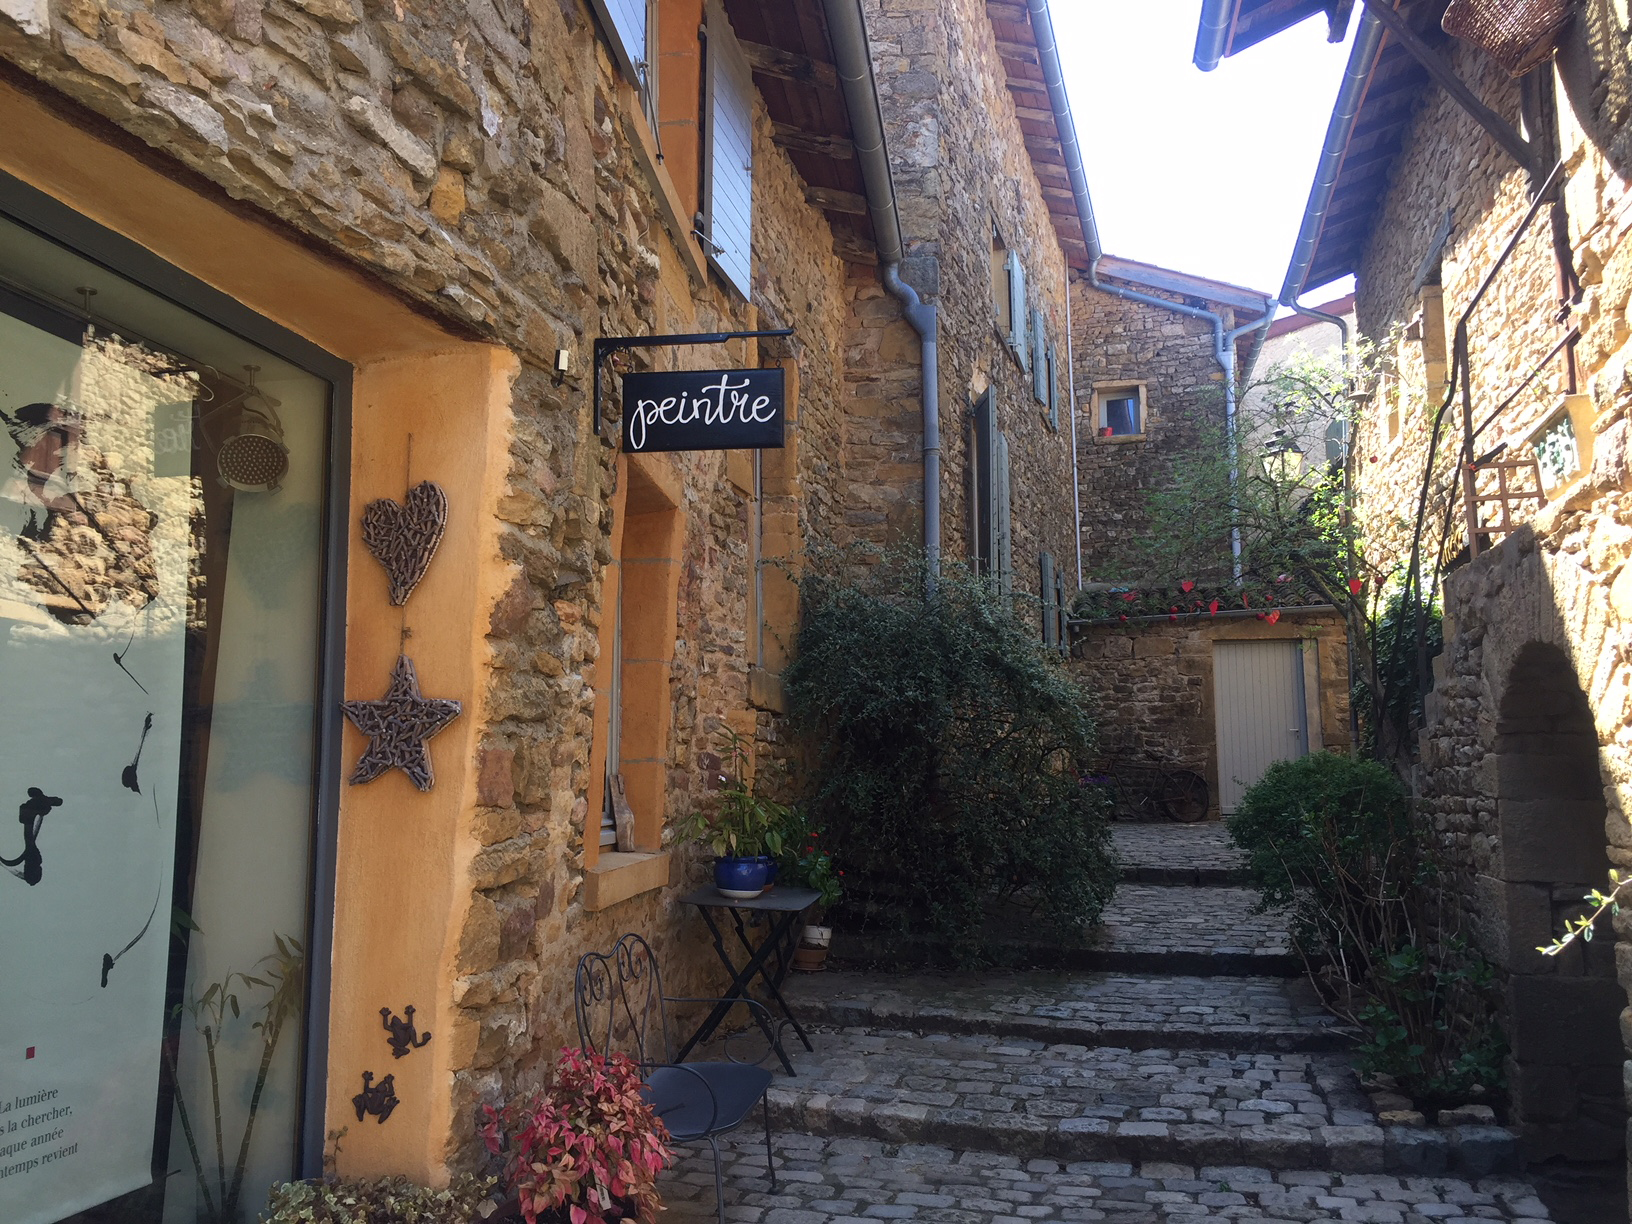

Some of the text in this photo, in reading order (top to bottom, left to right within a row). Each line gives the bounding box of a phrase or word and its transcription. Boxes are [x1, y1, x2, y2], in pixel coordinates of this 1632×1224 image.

[630, 374, 776, 449] peintre
[15, 1089, 58, 1109] lumière
[7, 1120, 17, 1133] la
[21, 1106, 73, 1129] chercher,
[30, 1127, 64, 1147] année
[41, 1142, 78, 1165] revient
